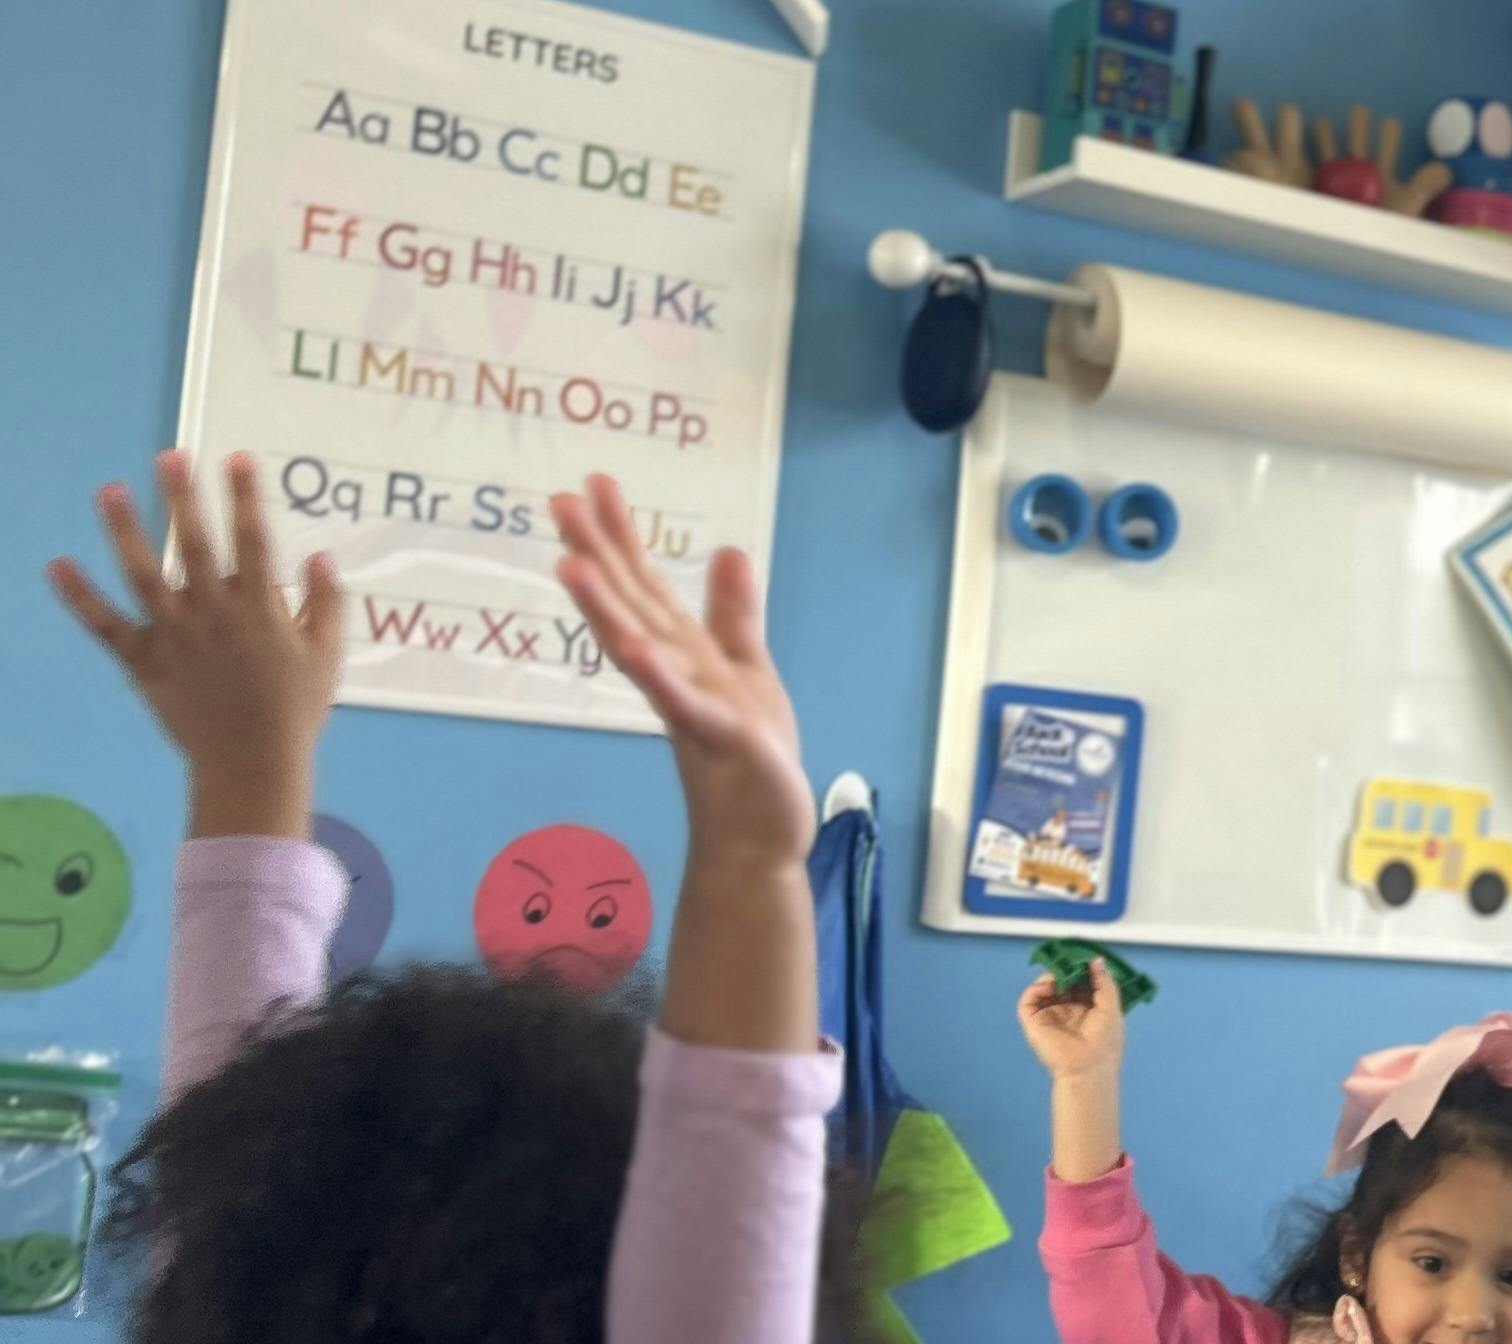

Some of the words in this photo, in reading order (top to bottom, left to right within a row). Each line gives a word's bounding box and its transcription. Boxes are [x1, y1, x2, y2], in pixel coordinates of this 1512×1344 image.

[463, 22, 621, 84] LETTERS
[314, 88, 391, 145] Aa
[409, 106, 481, 163] Bb
[497, 127, 561, 182] Cc
[578, 143, 650, 199] Dd
[668, 162, 723, 216] Ee
[301, 202, 360, 260] Ff
[377, 222, 453, 288] Gg
[469, 237, 538, 296] Hh
[590, 265, 638, 327] Jj
[651, 273, 717, 330] Kk
[357, 341, 456, 402] Mm
[473, 360, 545, 418] Nn
[558, 377, 634, 432] Oo
[648, 391, 709, 450] Pp
[281, 455, 364, 523] Qq
[383, 470, 451, 523] Rr
[470, 485, 533, 537] Ss
[364, 594, 461, 652] Ww
[476, 607, 541, 660] Xx
[553, 617, 603, 677] Yy
